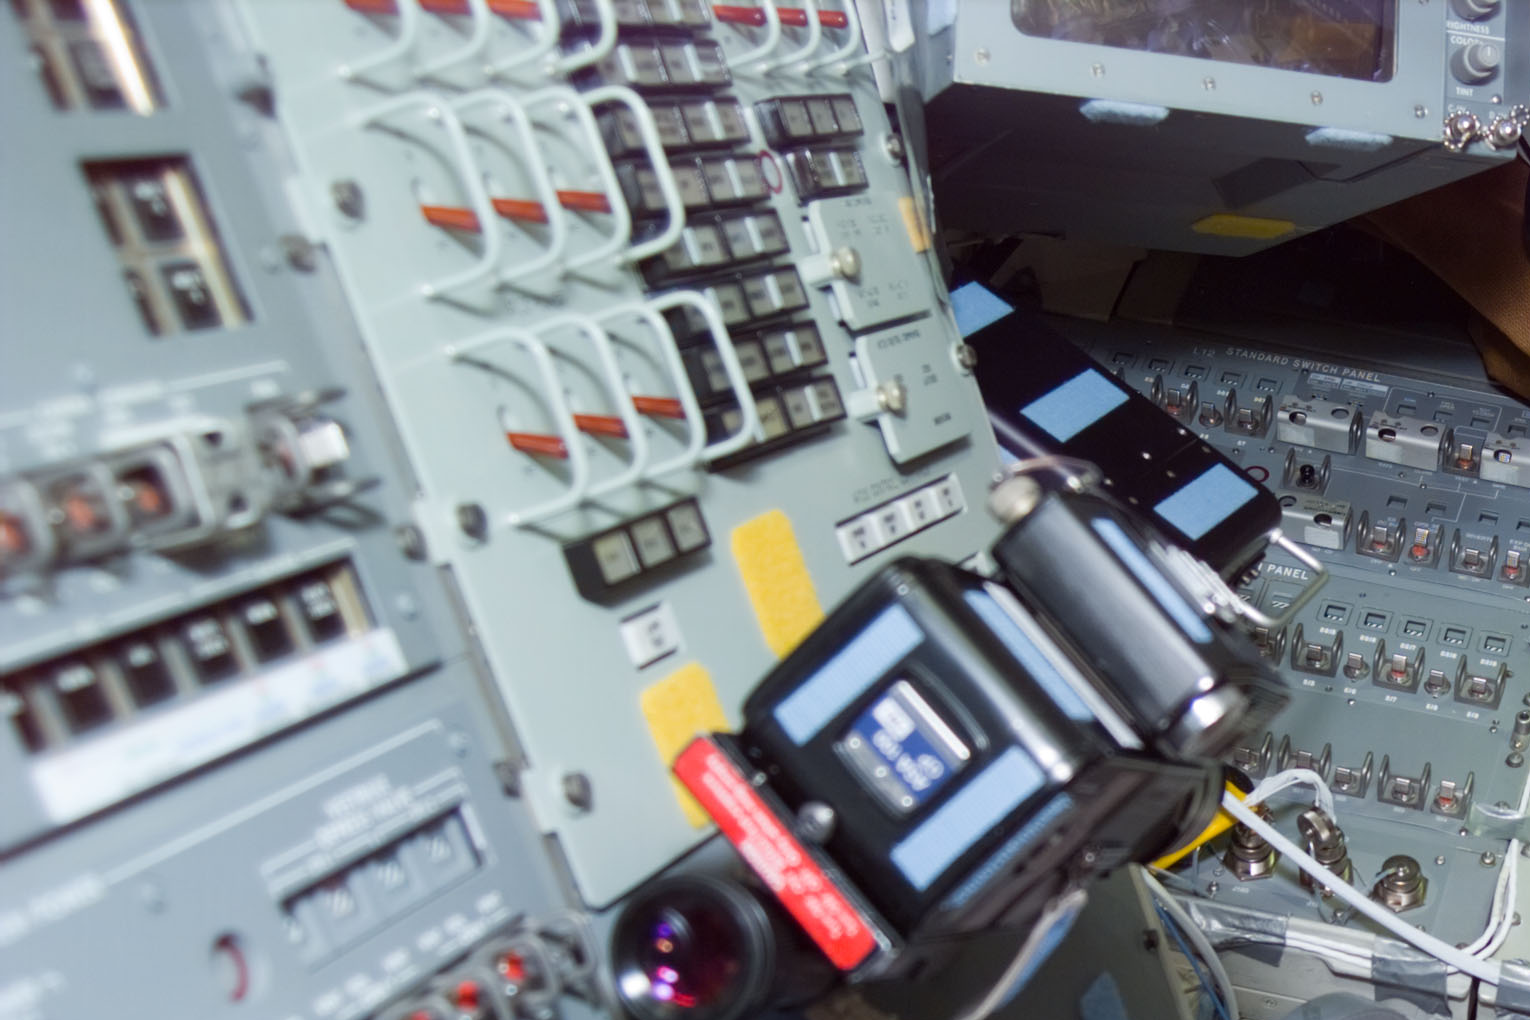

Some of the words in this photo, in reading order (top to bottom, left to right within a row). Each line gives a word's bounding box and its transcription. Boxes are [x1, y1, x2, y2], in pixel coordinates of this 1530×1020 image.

[1456, 86, 1474, 97] TINT
[1225, 347, 1290, 366] STANDARD
[1292, 359, 1338, 375] SWITCH
[1342, 367, 1382, 383] PANEL
[1267, 563, 1310, 581] PANEL
